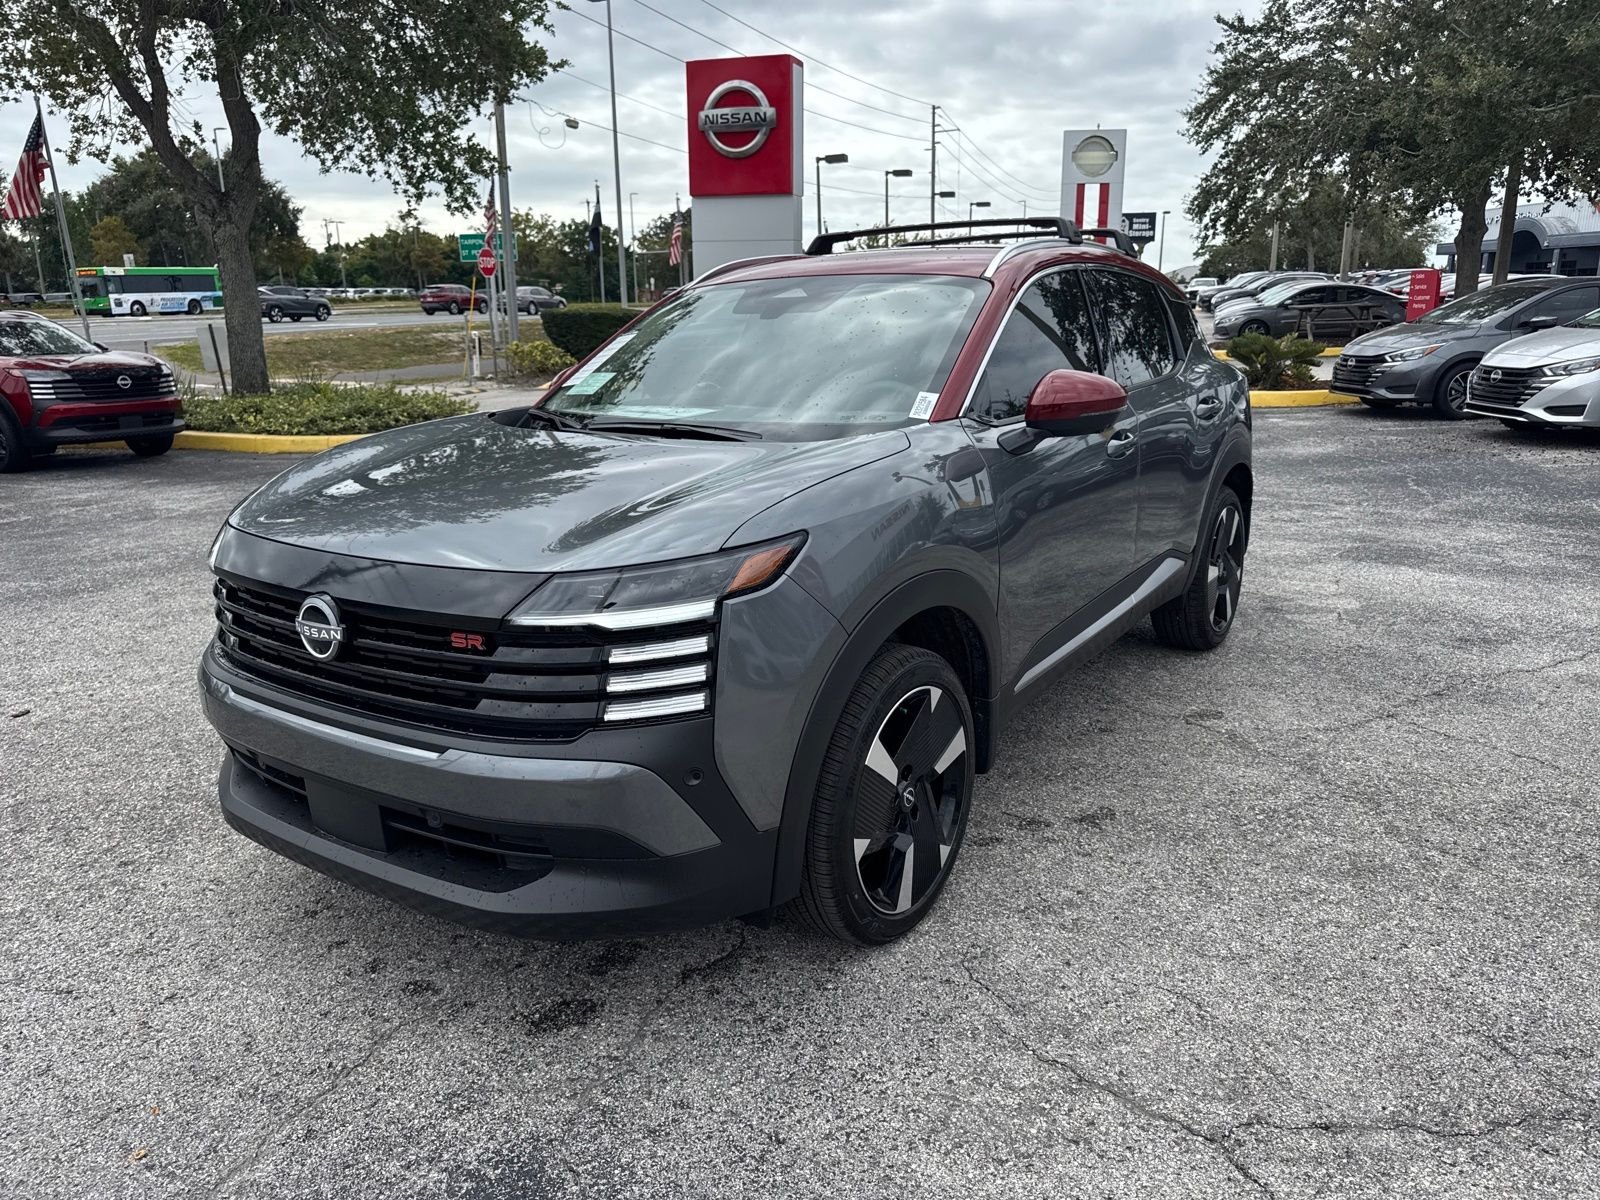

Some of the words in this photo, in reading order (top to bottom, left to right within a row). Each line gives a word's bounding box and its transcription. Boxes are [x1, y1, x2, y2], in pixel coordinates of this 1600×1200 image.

[704, 111, 767, 126] NISSAN
[480, 257, 496, 268] STOP
[451, 632, 484, 650] SR
